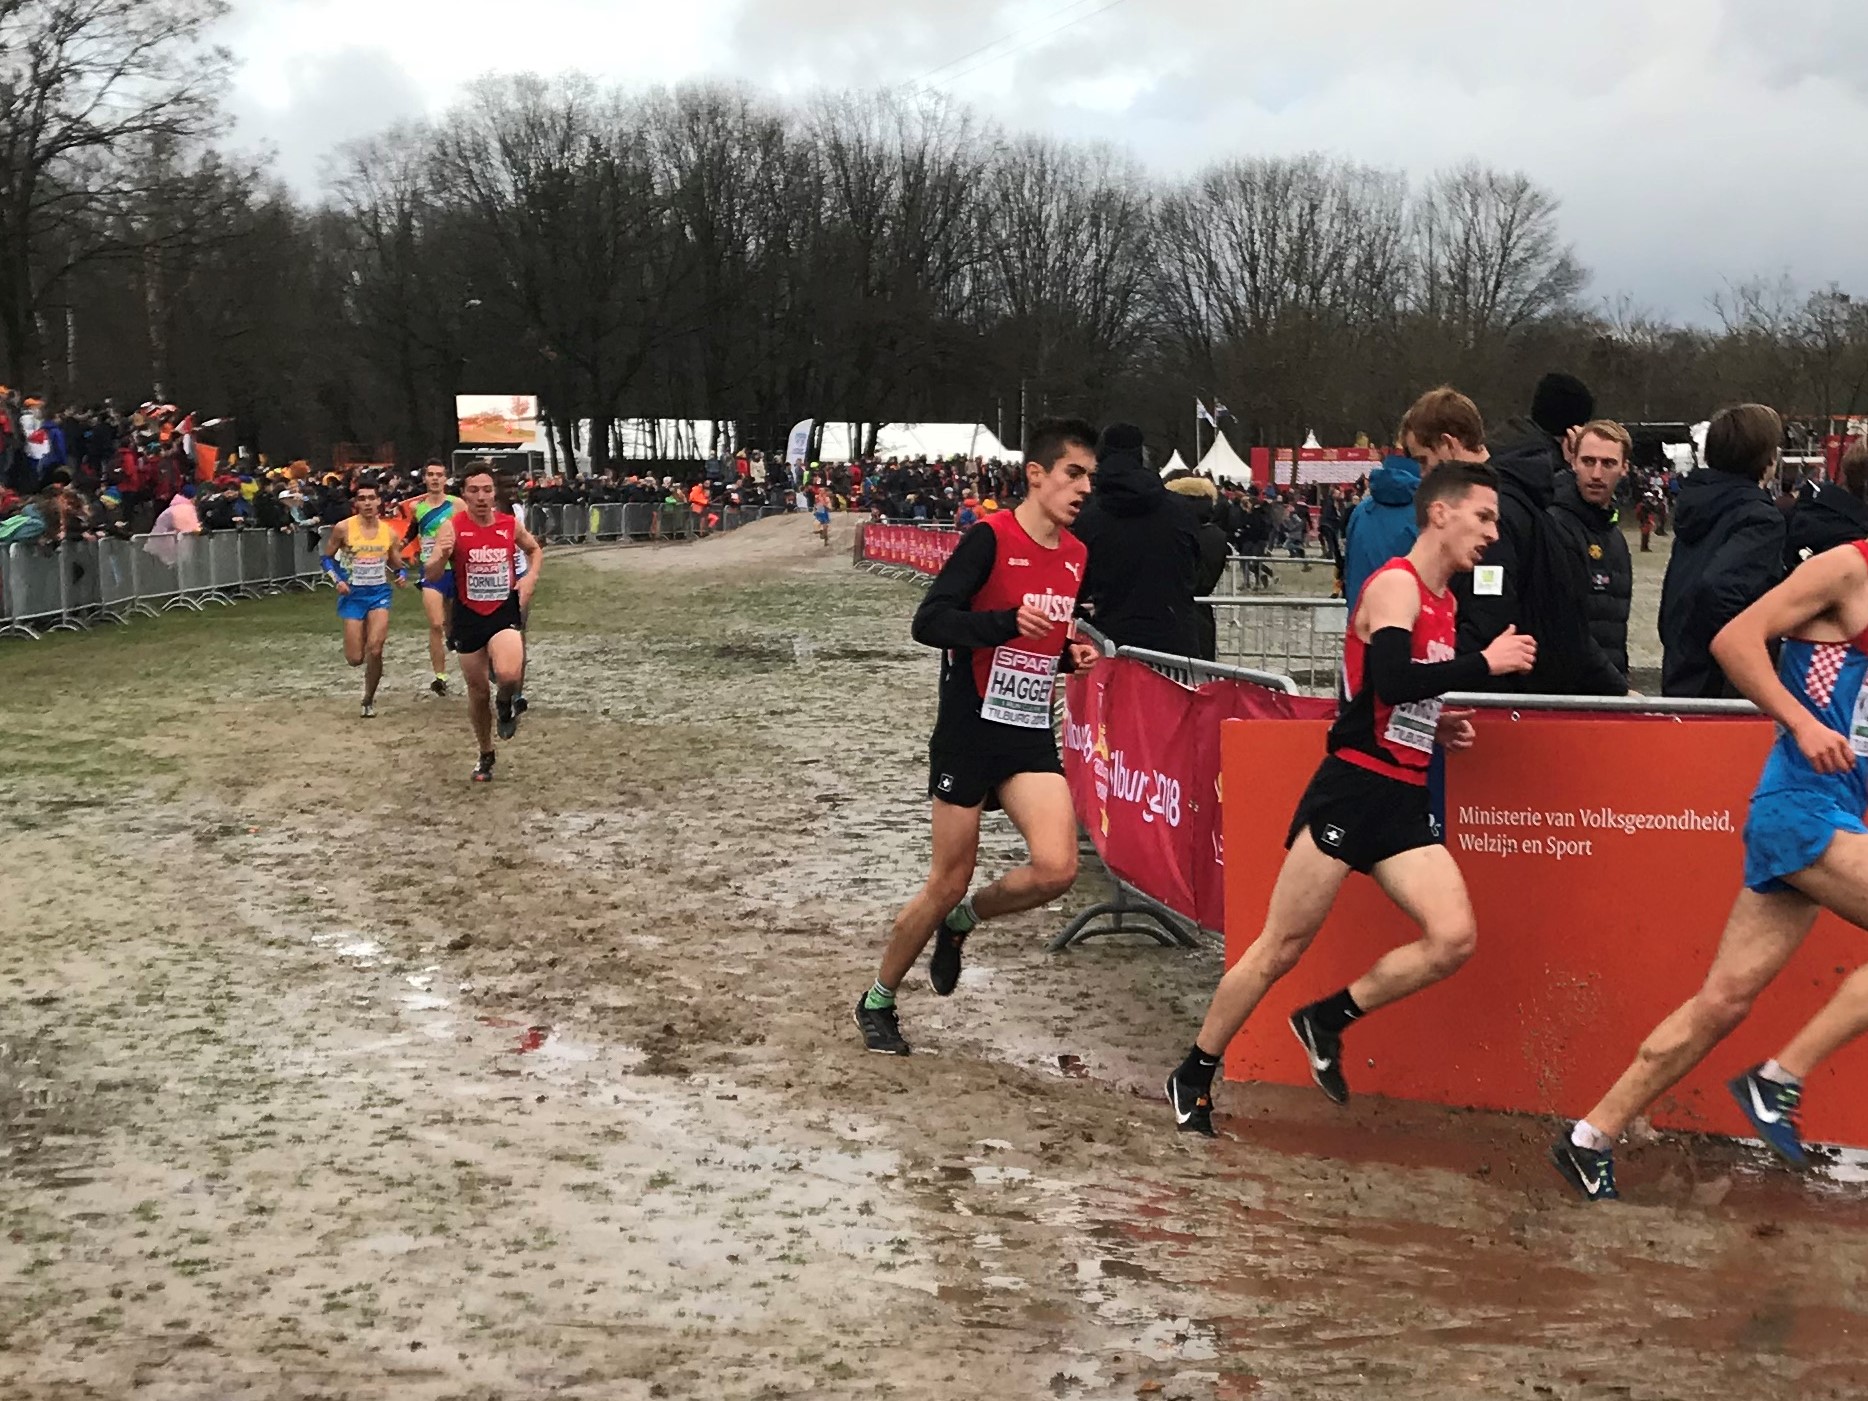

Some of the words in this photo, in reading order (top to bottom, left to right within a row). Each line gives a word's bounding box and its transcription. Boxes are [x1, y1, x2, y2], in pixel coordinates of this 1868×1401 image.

[998, 651, 1050, 674] SPAR
[988, 707, 1030, 724] TILBURG
[1459, 806, 1542, 826] Ministerie
[1544, 812, 1575, 827] van
[1579, 807, 1735, 834] Volksgezondheid,
[1458, 832, 1518, 858] Welzijn
[1522, 839, 1542, 854] en
[1545, 836, 1592, 860] Sport
